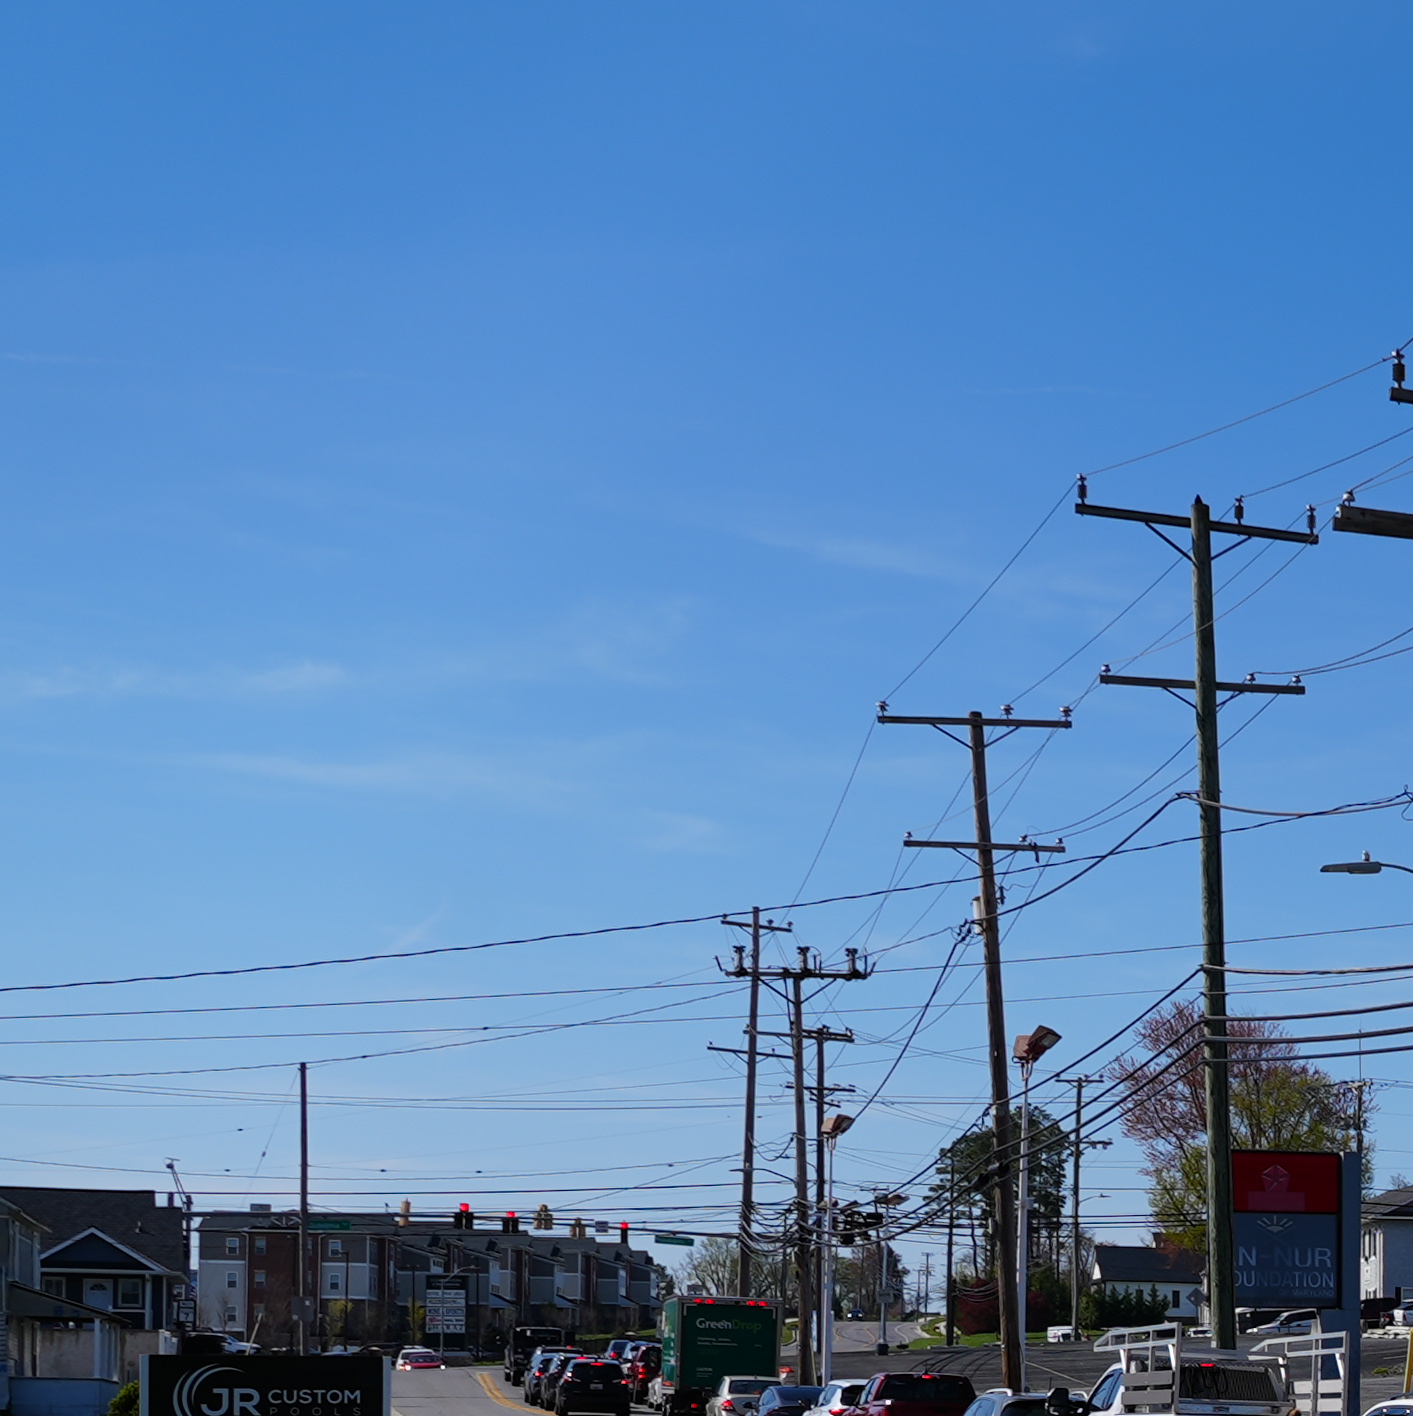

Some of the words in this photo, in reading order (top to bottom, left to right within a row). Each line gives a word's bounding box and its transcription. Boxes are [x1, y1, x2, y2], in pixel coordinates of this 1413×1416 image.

[1234, 1246, 1332, 1268] N-NUR
[1234, 1270, 1334, 1288] OUNDATION
[1292, 1289, 1334, 1297] MARYLAND
[696, 1317, 762, 1334] GreenDrop
[200, 1388, 261, 1416] JR
[268, 1389, 361, 1404] CUSTOM
[269, 1407, 361, 1416] POOLS
